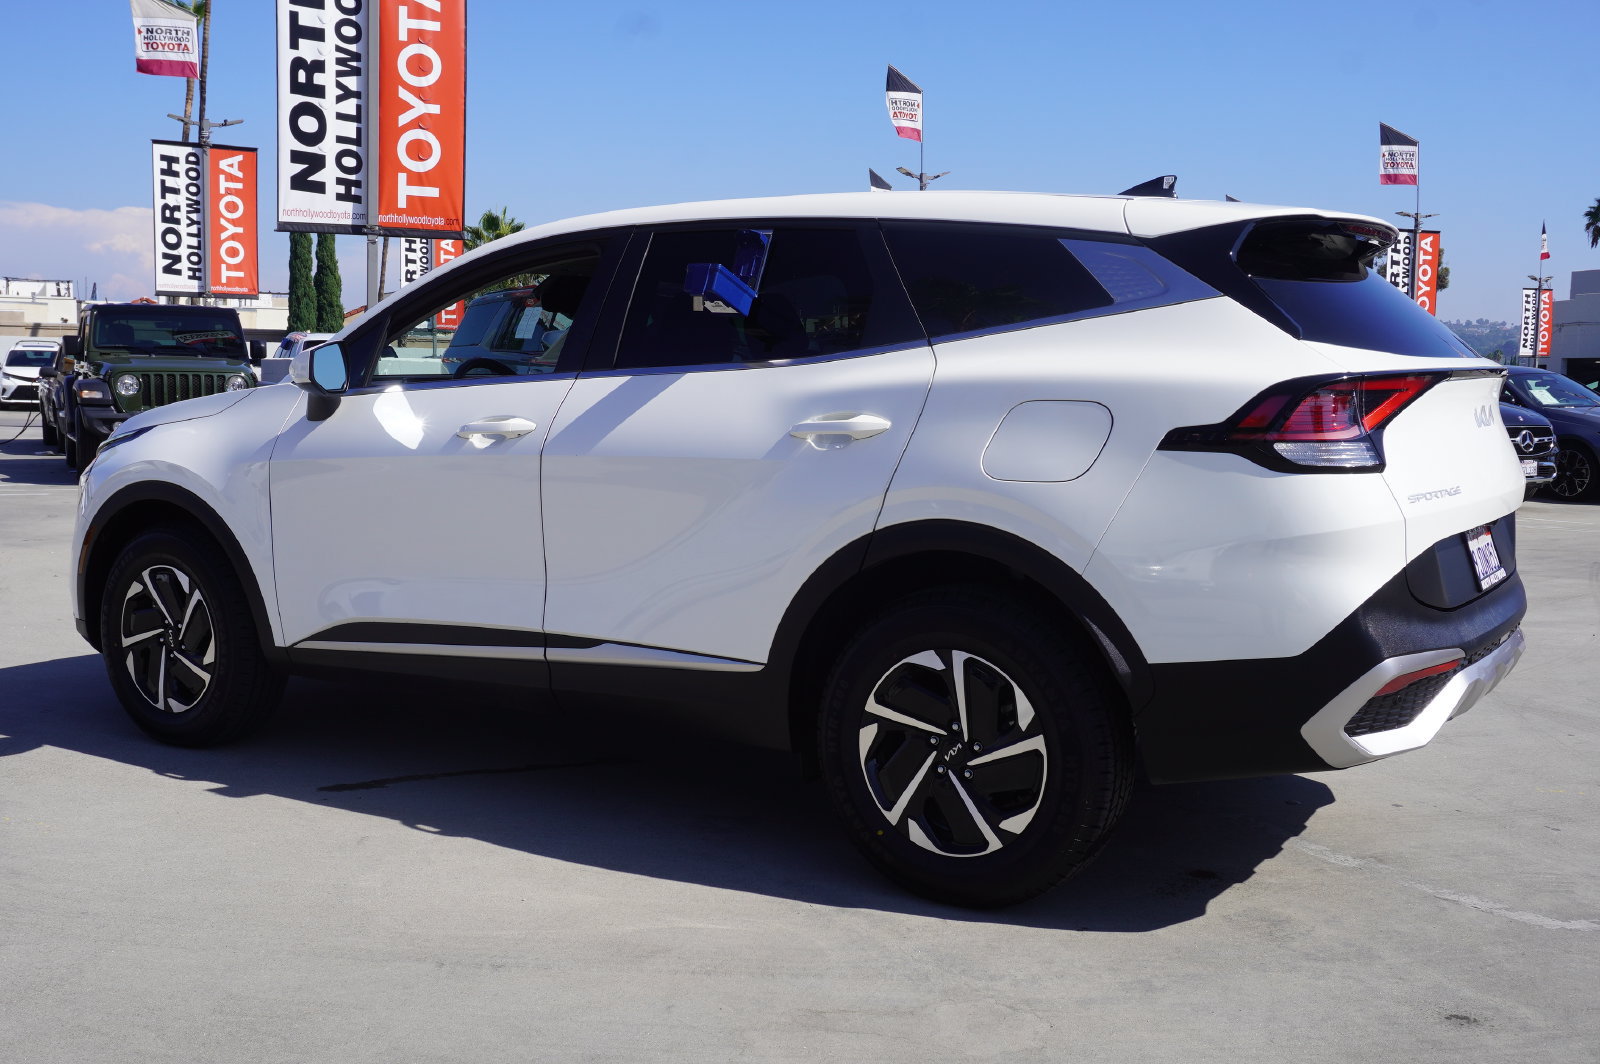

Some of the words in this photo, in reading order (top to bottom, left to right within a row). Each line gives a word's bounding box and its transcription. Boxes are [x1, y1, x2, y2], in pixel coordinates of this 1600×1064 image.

[143, 35, 190, 43] HOLLYWOOD
[143, 41, 190, 52] TOYOTA
[145, 27, 191, 36] NORTH
[289, 0, 327, 194] NORT
[160, 154, 183, 276] NORTH
[185, 151, 203, 281] HOLLYWOOD
[219, 154, 245, 283] TOYOTA
[282, 208, 366, 222] northhollywoodtoyota.com
[404, 238, 418, 283] RTH
[1390, 239, 1402, 288] RTH
[1417, 235, 1434, 311] OYOTA
[1522, 293, 1531, 349] NORTH
[1529, 292, 1537, 350] HOLLYWOOD
[1538, 291, 1550, 351] TOYOTA
[1407, 485, 1462, 504] SPORTAGE
